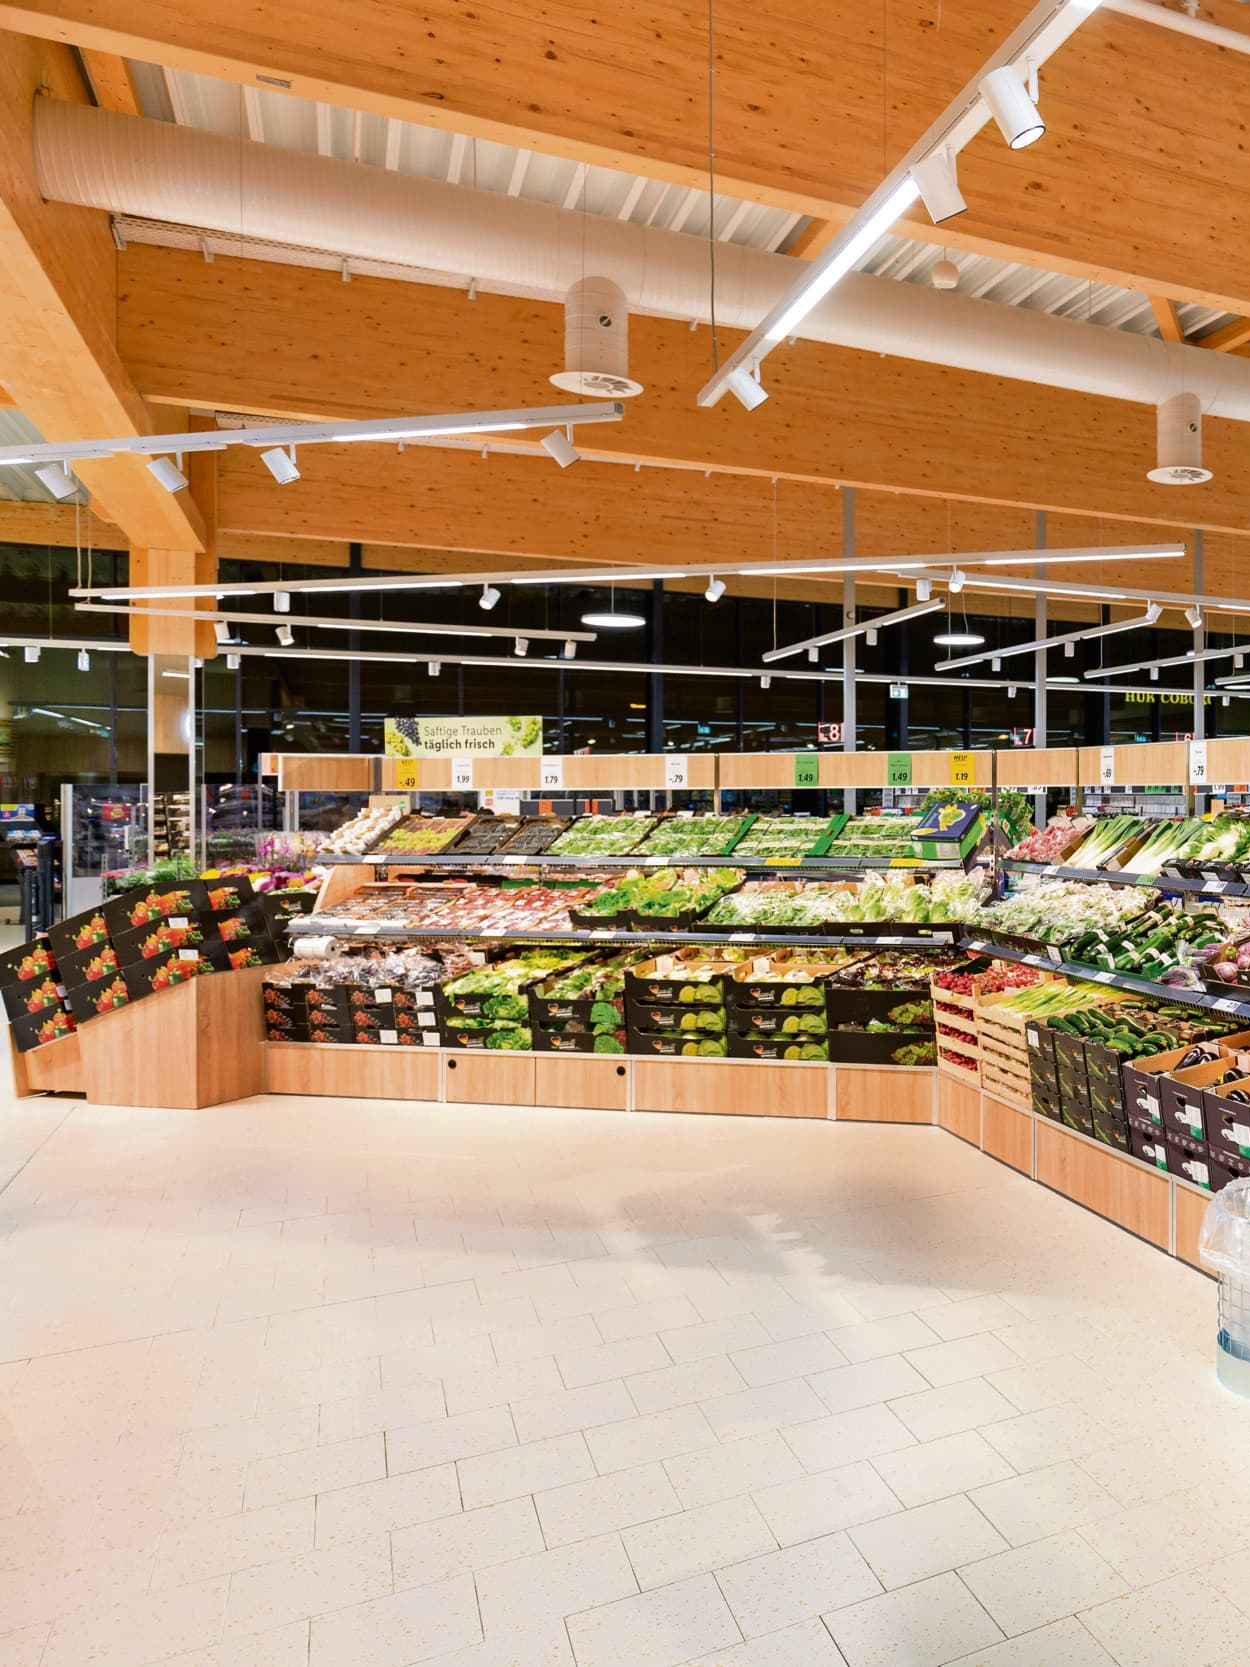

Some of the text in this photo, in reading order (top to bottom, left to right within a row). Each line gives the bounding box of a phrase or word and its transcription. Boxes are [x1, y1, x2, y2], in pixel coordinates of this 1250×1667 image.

[424, 725, 502, 737] Saftige Trauben
[424, 738, 495, 752] täglich frisch
[798, 773, 813, 782] 1.49
[892, 772, 908, 782] 1.49
[955, 772, 969, 781] 1.19
